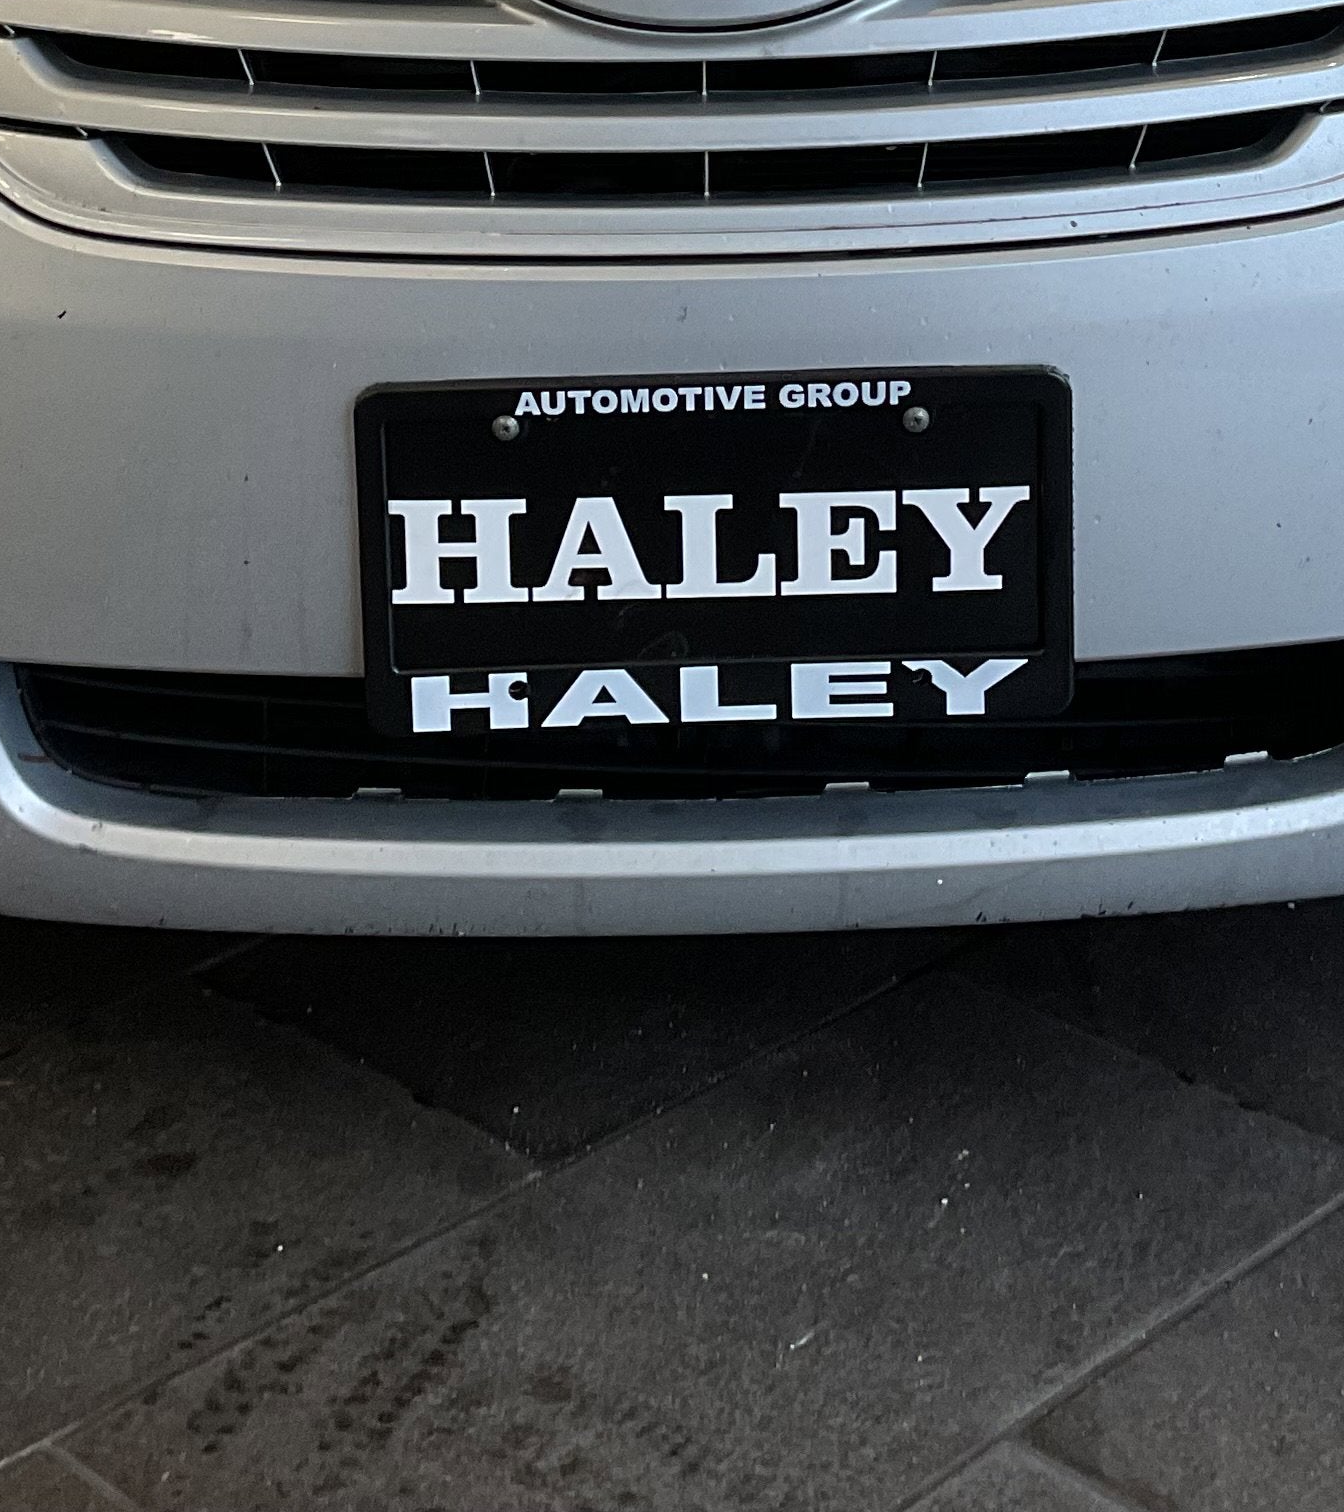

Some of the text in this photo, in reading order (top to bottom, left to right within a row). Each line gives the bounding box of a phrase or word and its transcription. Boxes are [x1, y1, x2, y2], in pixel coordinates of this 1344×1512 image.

[514, 380, 912, 417] AUTOMOTIVE GROUP
[387, 485, 1031, 605] HALEY
[410, 658, 1029, 733] HALEY
